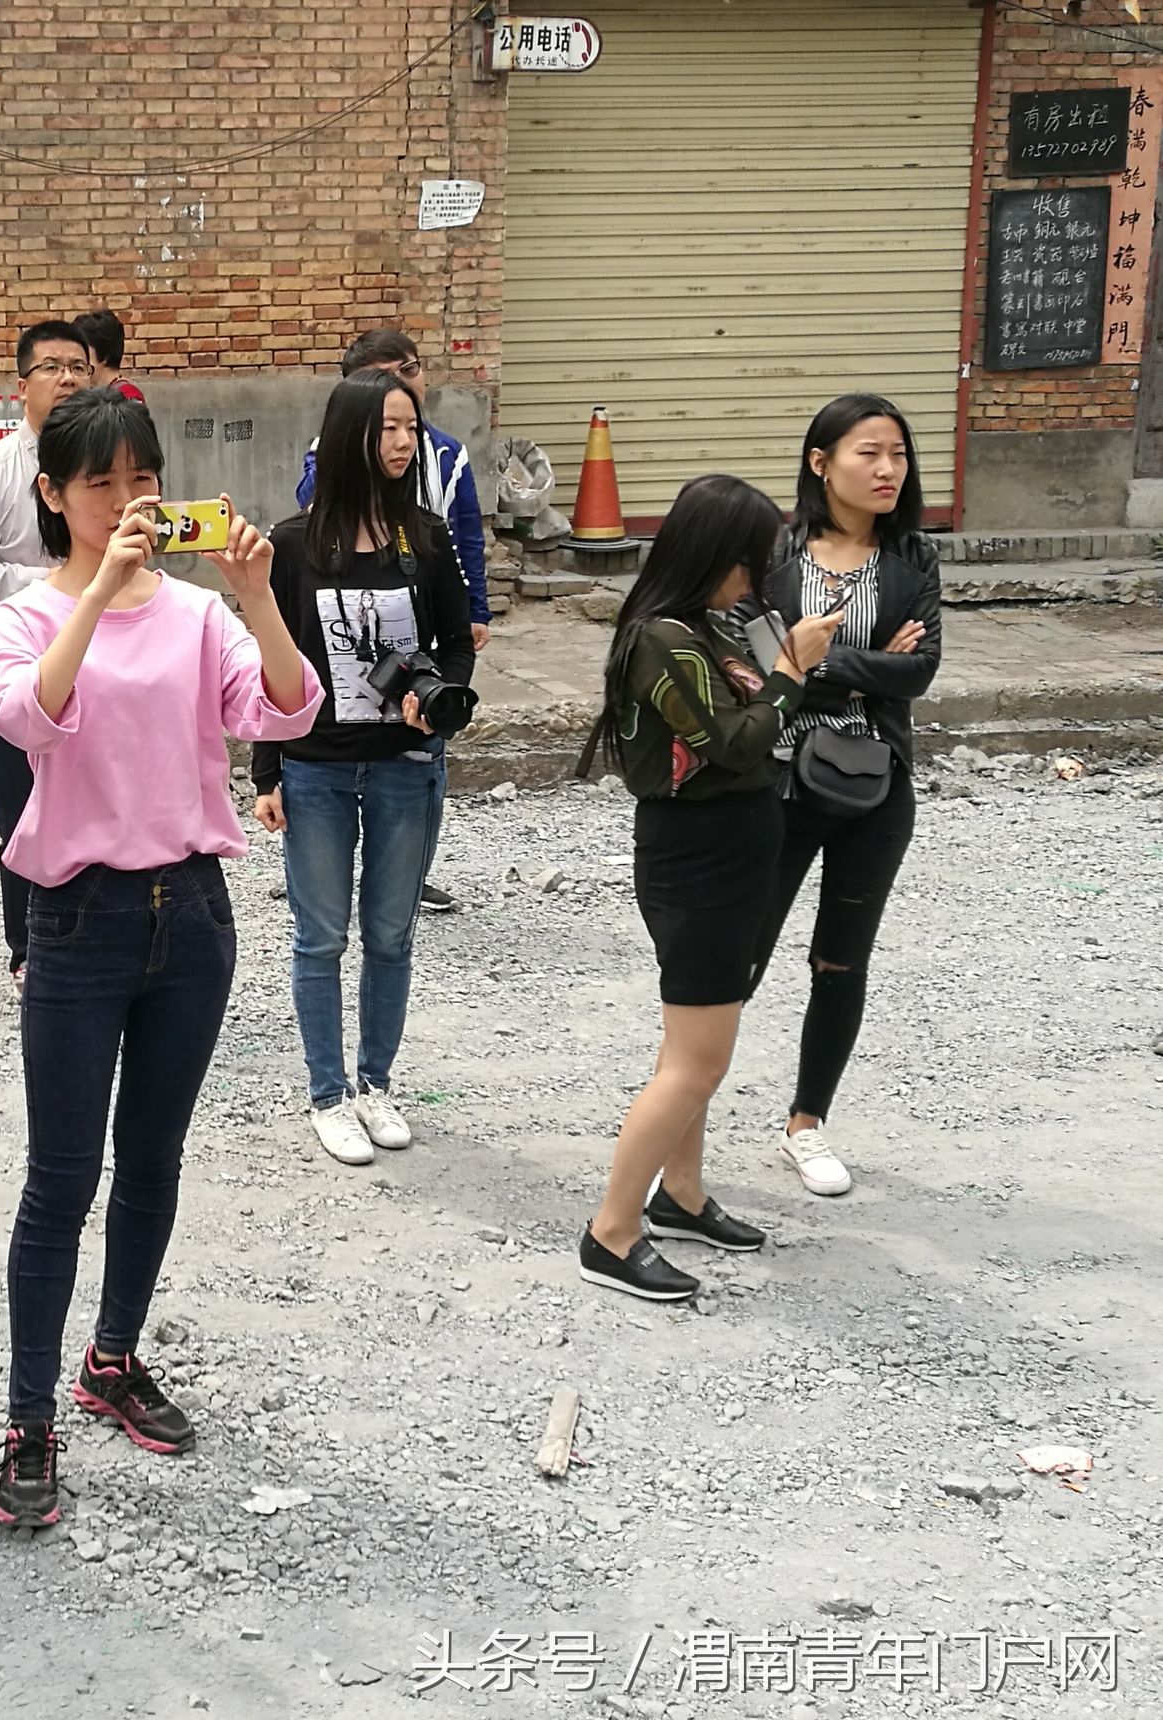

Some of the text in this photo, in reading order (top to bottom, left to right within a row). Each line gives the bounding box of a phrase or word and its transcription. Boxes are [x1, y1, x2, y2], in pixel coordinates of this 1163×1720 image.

[500, 24, 571, 53] 公用电话
[1023, 103, 1109, 134] 有房出租
[1032, 193, 1071, 218] 收售
